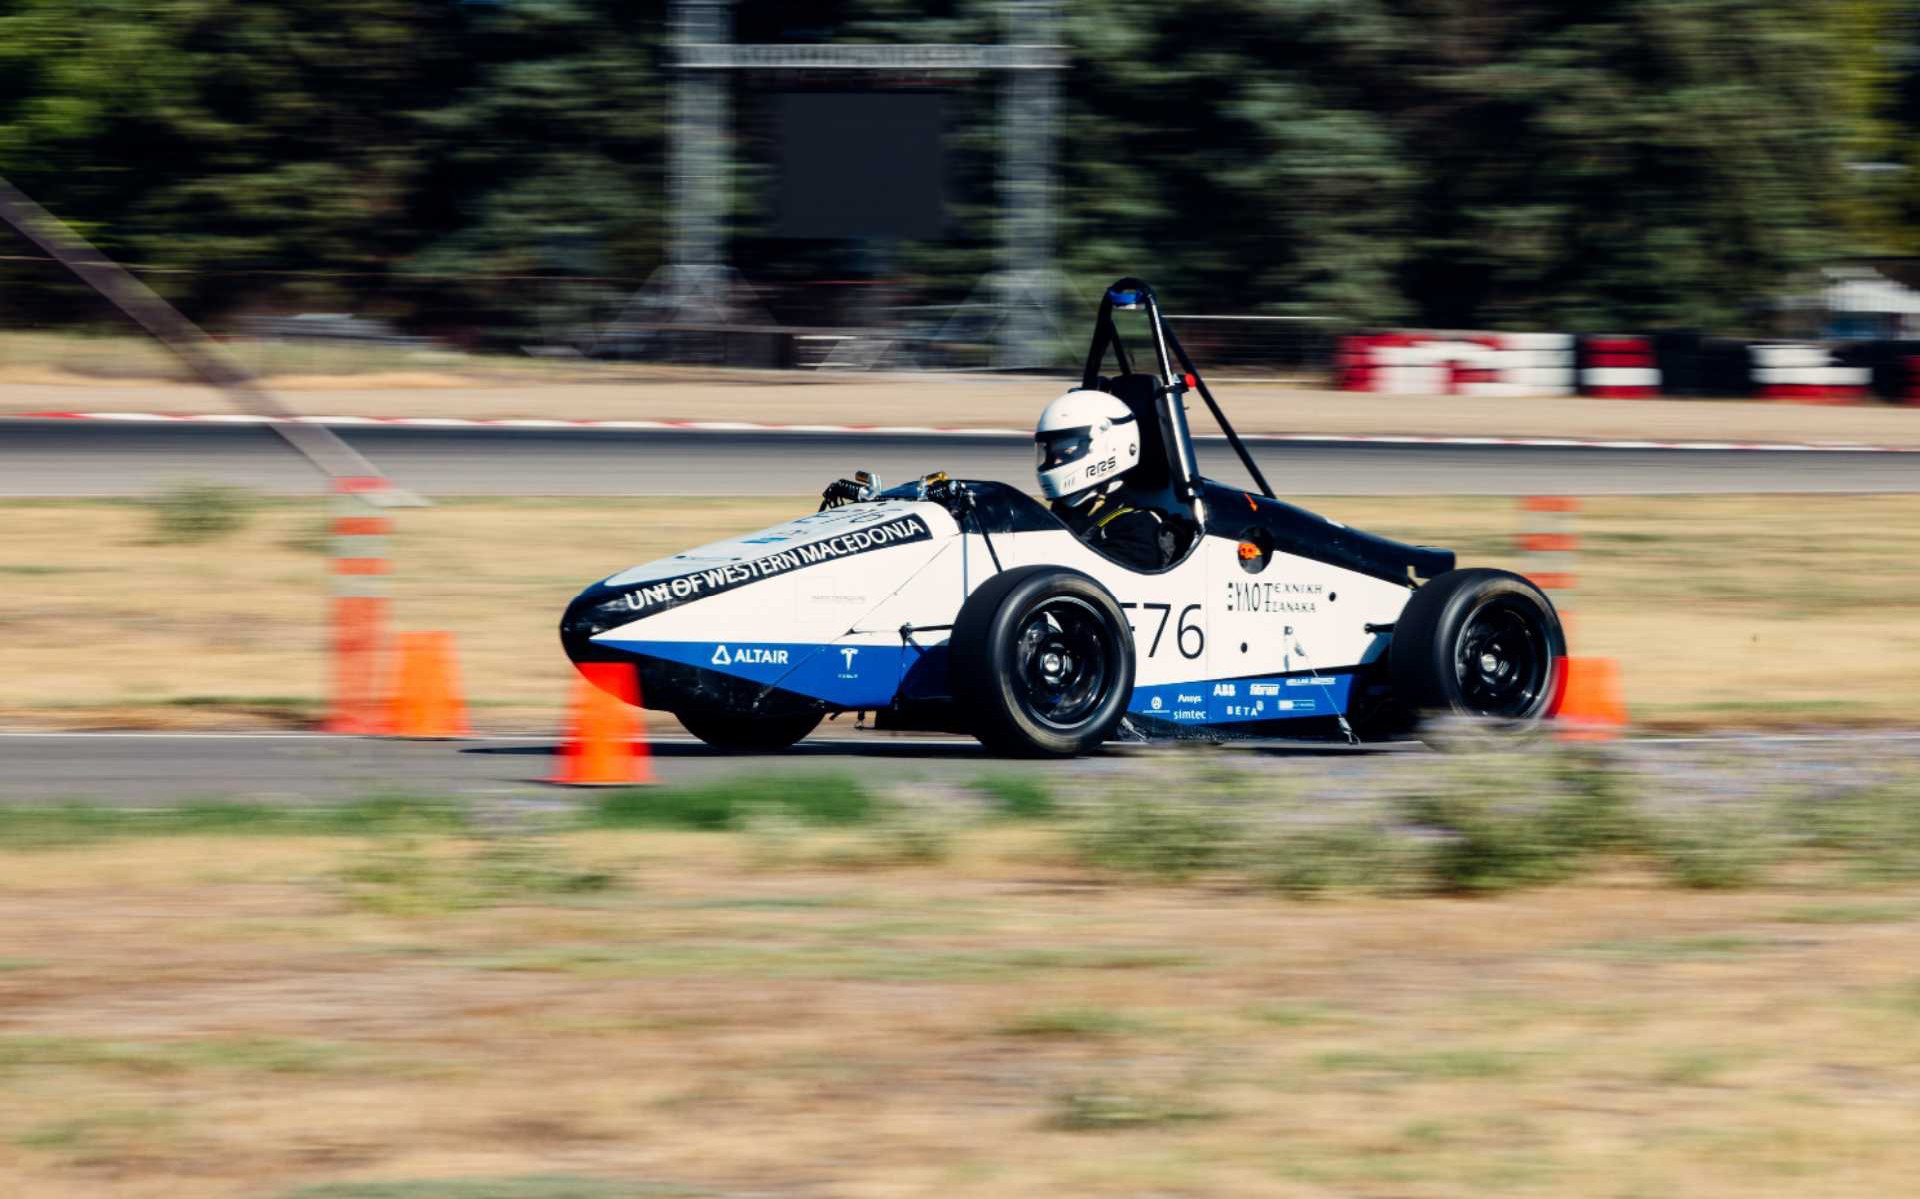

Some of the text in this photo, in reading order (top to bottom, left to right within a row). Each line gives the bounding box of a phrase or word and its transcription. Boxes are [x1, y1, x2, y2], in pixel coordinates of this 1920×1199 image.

[1086, 455, 1116, 478] RRS
[624, 582, 673, 611] UNI
[671, 574, 704, 597] OF
[700, 551, 801, 589] WESTERN
[797, 519, 925, 564] MACEDONIA
[734, 648, 789, 665] ALTAIR
[1213, 683, 1237, 697] ABB
[1173, 709, 1207, 720] simtec
[1226, 705, 1259, 717] BETA
